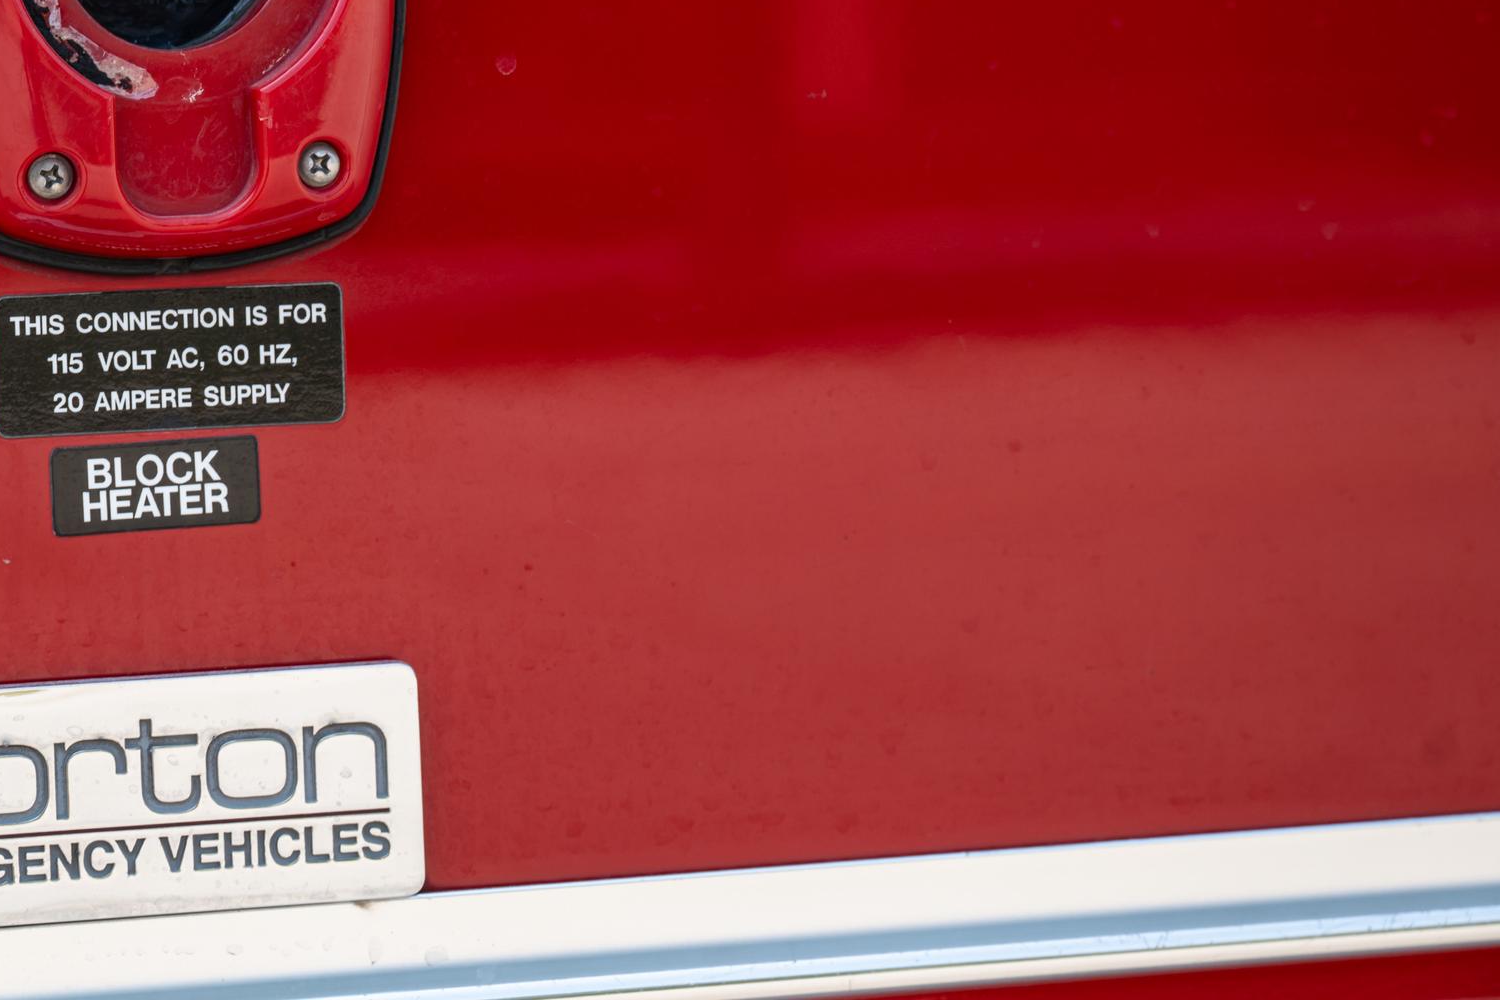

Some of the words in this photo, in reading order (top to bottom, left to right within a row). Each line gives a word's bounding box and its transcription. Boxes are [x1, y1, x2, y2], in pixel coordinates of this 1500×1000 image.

[9, 314, 65, 337] THIS
[75, 307, 235, 334] CONNECTION
[245, 305, 268, 326] IS
[278, 302, 327, 325] FOR
[47, 352, 84, 375] 115
[97, 349, 157, 372] VOLT
[166, 346, 206, 372] AC,
[217, 344, 250, 366] 60
[259, 343, 298, 368] HZ,
[53, 391, 84, 414] 20
[94, 387, 193, 412] AMPERE
[203, 382, 291, 407] SUPPLY
[86, 449, 222, 490] BLOCK
[82, 482, 230, 523] HEATER
[159, 820, 392, 873] VEHICLES
